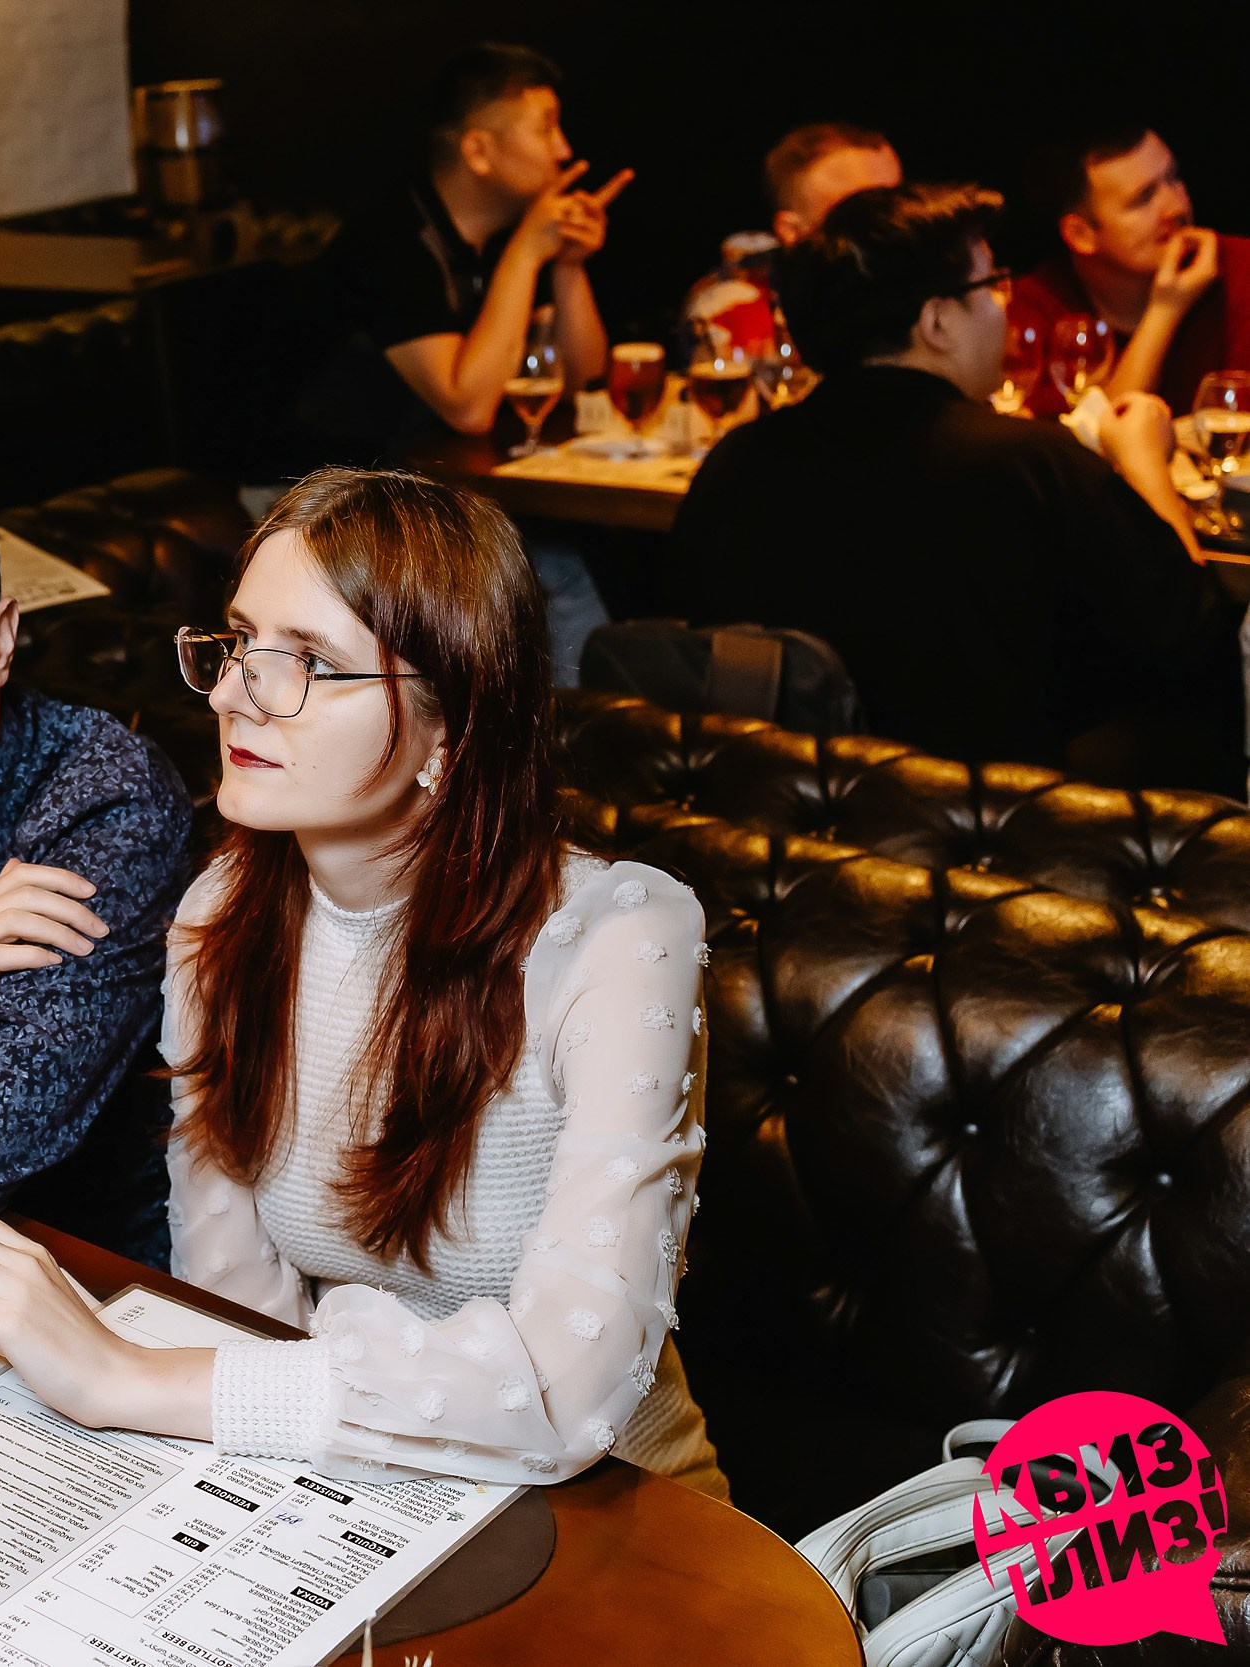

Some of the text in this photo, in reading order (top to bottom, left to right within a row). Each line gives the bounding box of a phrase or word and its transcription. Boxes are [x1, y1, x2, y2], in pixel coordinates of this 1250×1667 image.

[93, 1463, 114, 1474] BEACH
[231, 1470, 280, 1494] MARTINI BIANCO
[239, 1467, 286, 1489] MARTINI ROSSO
[65, 1482, 118, 1510] SUMMER HIGHBALL
[107, 1486, 132, 1499] GRANT'S
[200, 1483, 254, 1508] VERMOUTH
[248, 1484, 275, 1499] MARTINI
[301, 1480, 344, 1501] WHISKEY
[404, 1483, 455, 1507] GRANT'S TRIPLE
[432, 1488, 460, 1502] GRANT'S
[438, 1483, 466, 1497] GRANT'S
[52, 1494, 103, 1521] TROPICAL GRANT'S
[404, 1497, 443, 1516] TULLAMORE
[410, 1492, 449, 1511] TULLAMORE
[67, 1517, 90, 1531] APEROL
[389, 1505, 433, 1525] GLENFIDDICH
[16, 1529, 36, 1541] TONIC
[47, 1527, 75, 1542] DAIQUIRI
[192, 1518, 227, 1536] BEEFEATER
[350, 1523, 378, 1537] BLANCO
[358, 1519, 410, 1544] MILAGRO SILVER
[40, 1541, 59, 1553] TULLY
[347, 1533, 387, 1555] TEQUILA
[377, 1534, 405, 1549] OLMECA
[18, 1548, 45, 1564] NEGRONI
[261, 1544, 291, 1561] ORIGINAL
[4, 1559, 29, 1575] TEQUILA
[289, 1558, 325, 1576] СТАНДАРТ
[323, 1560, 366, 1581] PURE DIVINE
[350, 1563, 371, 1576] TALKA
[314, 1576, 349, 1594] FINLANDIA
[321, 1587, 343, 1600] REYKA
[248, 1588, 317, 1622] PAULANER WEISSBIER
[254, 1583, 324, 1617] PAULANER WEISSBIER
[296, 1588, 329, 1608] VODKA
[219, 1607, 243, 1621] BLANC
[252, 1606, 305, 1633] HOLSTEN LIGHT
[268, 1605, 311, 1627] GRIMBERGEN
[241, 1617, 292, 1644] KRONENBOURG
[255, 1616, 299, 1639] KOZEL CERNY
[161, 1631, 188, 1647] BEER
[240, 1634, 279, 1656] CARLSBERG
[260, 1635, 286, 1650] MILLER
[89, 1637, 146, 1667] DRAFT BEER
[245, 1645, 273, 1661] GARAGE
